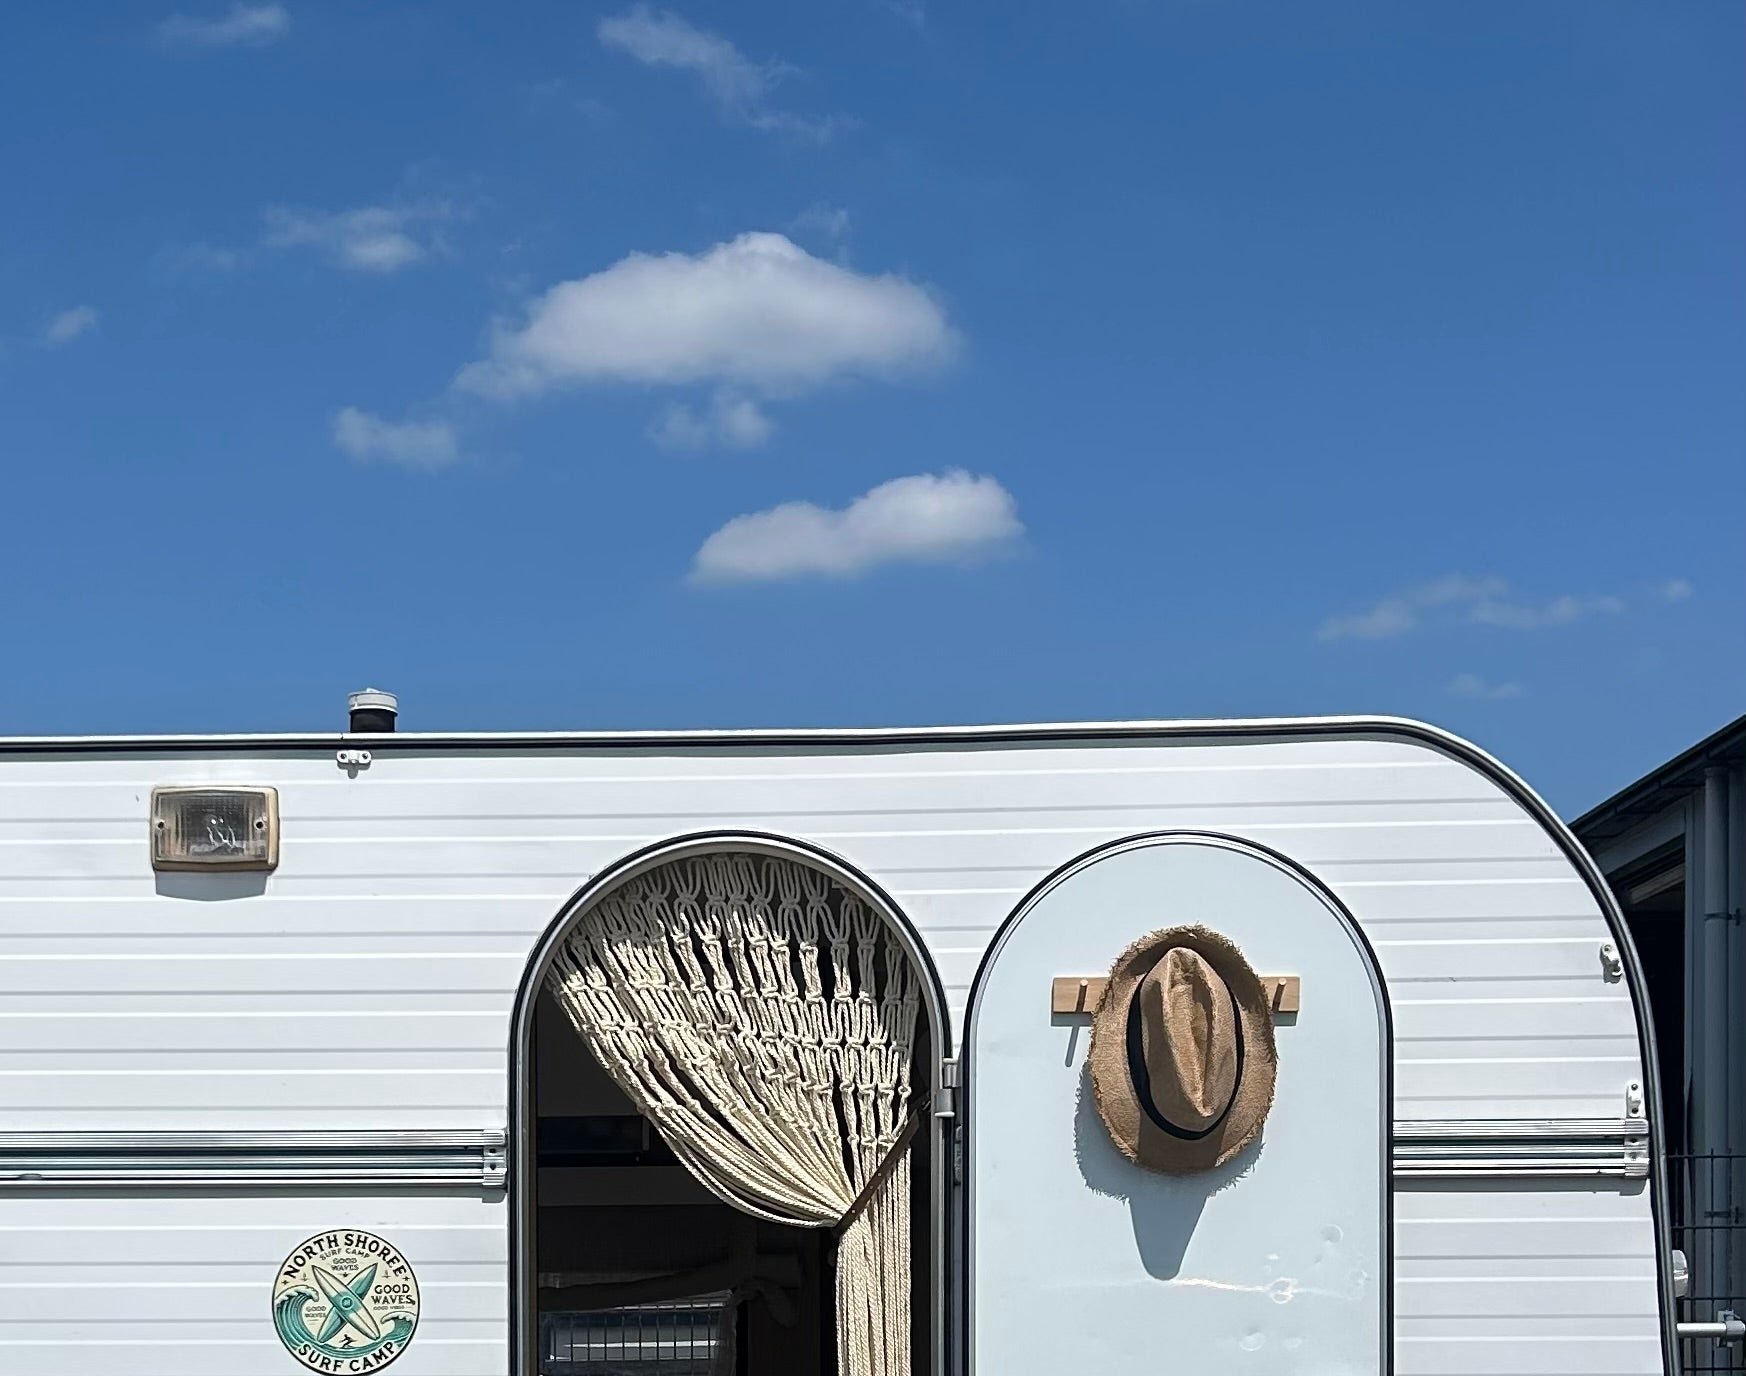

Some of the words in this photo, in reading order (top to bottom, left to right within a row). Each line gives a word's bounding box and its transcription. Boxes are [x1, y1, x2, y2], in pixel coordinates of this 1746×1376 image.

[284, 1234, 339, 1279] NORTH
[320, 1248, 342, 1260] SURF
[345, 1248, 370, 1259] CAMP
[374, 1284, 410, 1294] GOOD
[298, 1343, 344, 1372] SURF
[349, 1341, 395, 1372] CAMP
